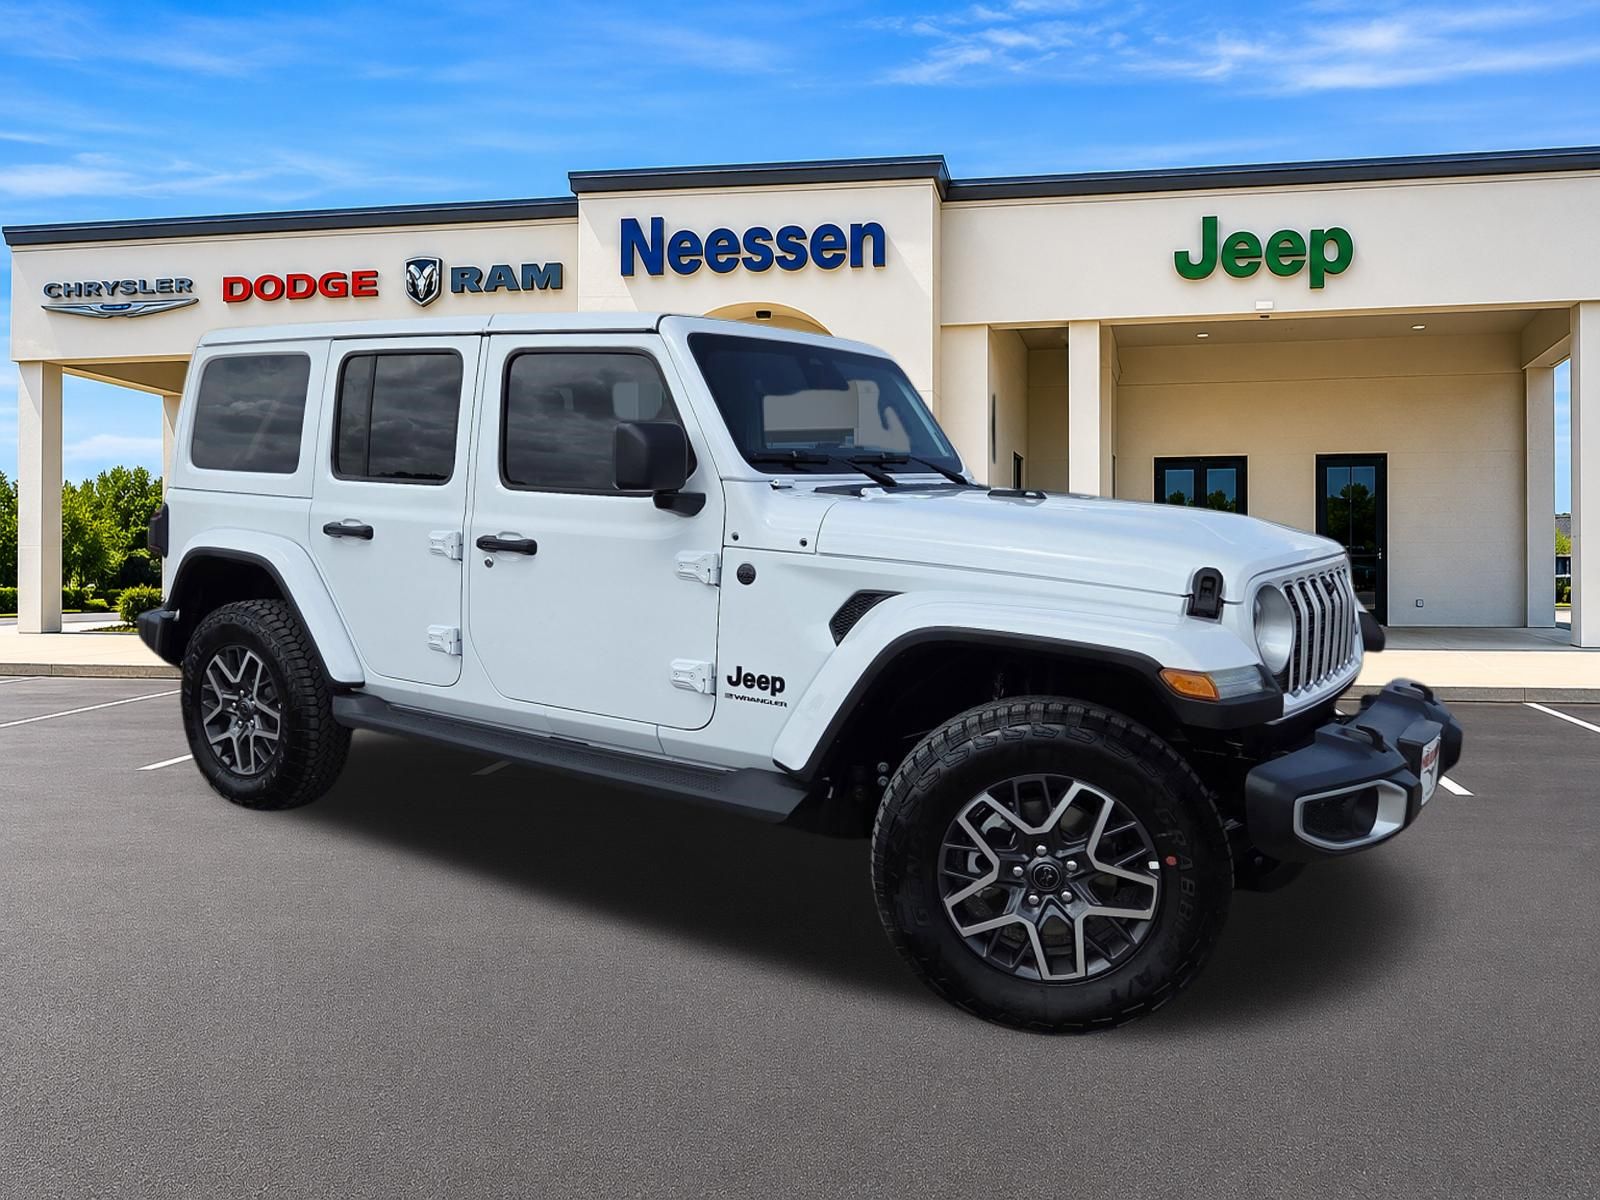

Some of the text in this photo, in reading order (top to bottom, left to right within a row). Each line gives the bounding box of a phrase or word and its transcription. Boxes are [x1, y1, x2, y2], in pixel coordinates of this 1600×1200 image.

[621, 216, 886, 277] Neessen
[1174, 215, 1354, 289] Jeep
[43, 277, 194, 299] CHRYSLER
[222, 270, 379, 304] DODGE
[450, 262, 564, 295] RAM
[727, 666, 785, 697] Jeep
[734, 694, 787, 707] WRANGLER
